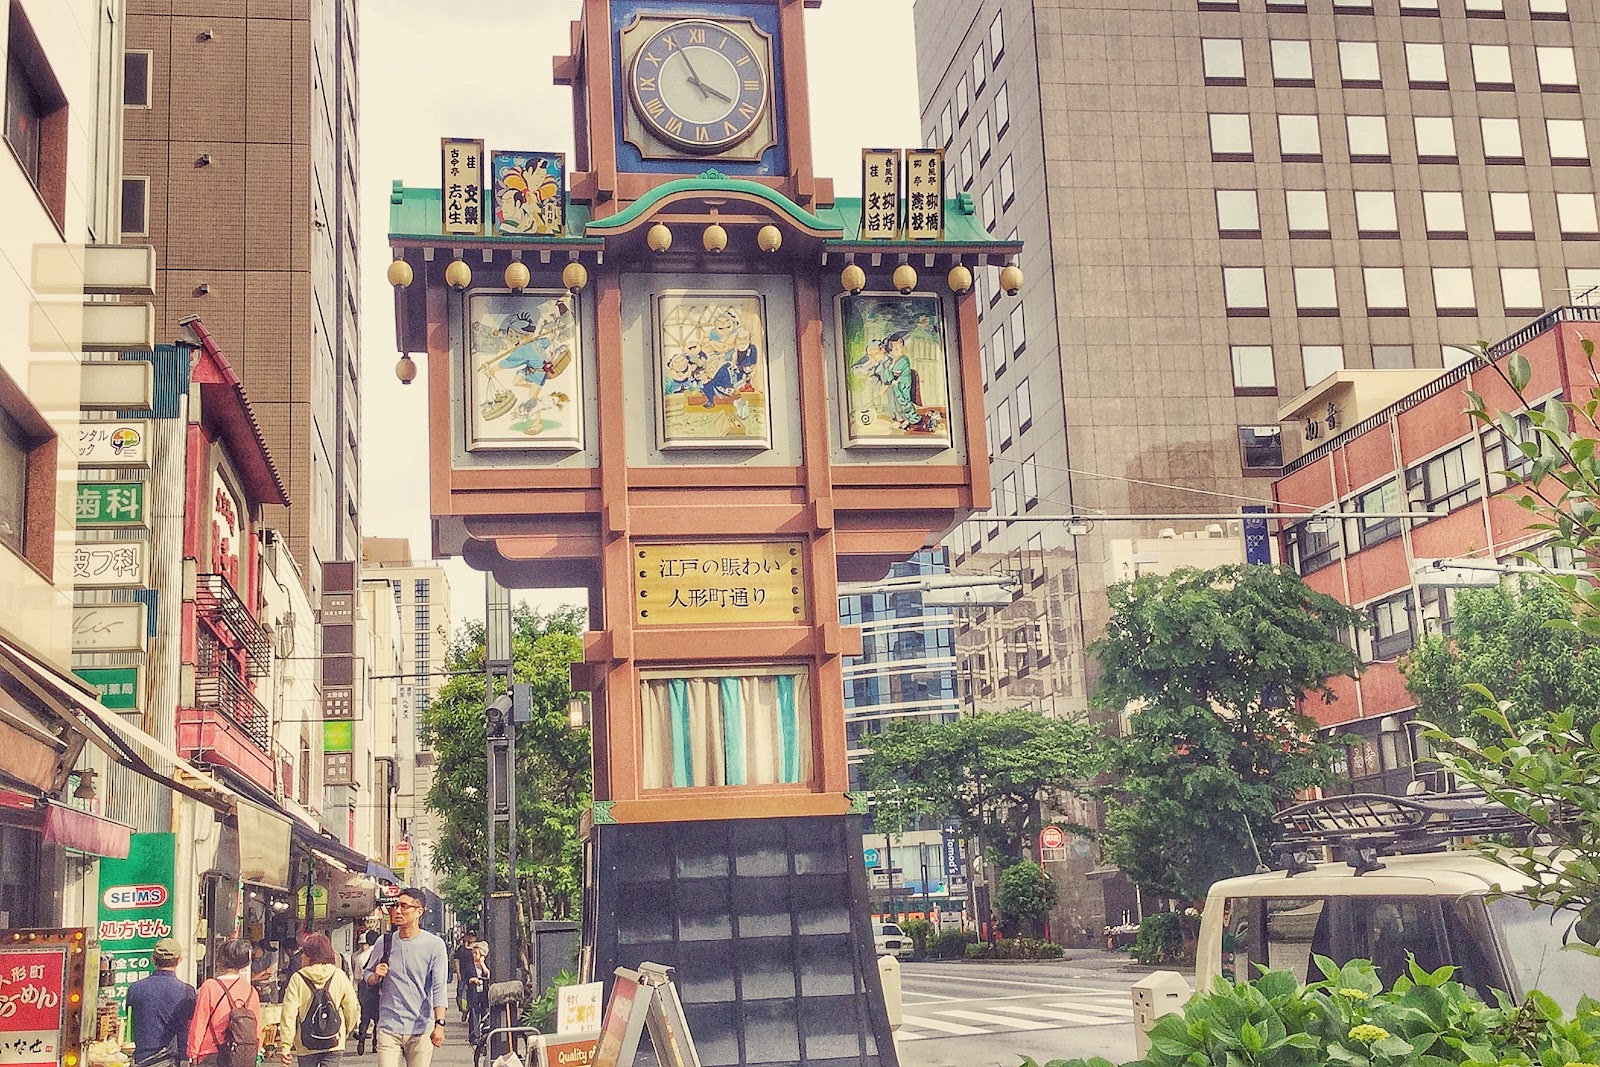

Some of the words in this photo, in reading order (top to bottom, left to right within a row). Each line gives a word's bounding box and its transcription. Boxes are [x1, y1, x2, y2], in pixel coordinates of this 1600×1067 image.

[689, 28, 706, 44] XII
[744, 80, 760, 91] III
[76, 488, 140, 519] 歯科
[659, 557, 781, 578] 江戸の賑わい
[668, 587, 767, 608] 人形町通り
[110, 890, 160, 903] SEIMS
[100, 919, 170, 939] 処方せん
[115, 957, 150, 970] 全ての
[558, 1047, 588, 1065] Quality
